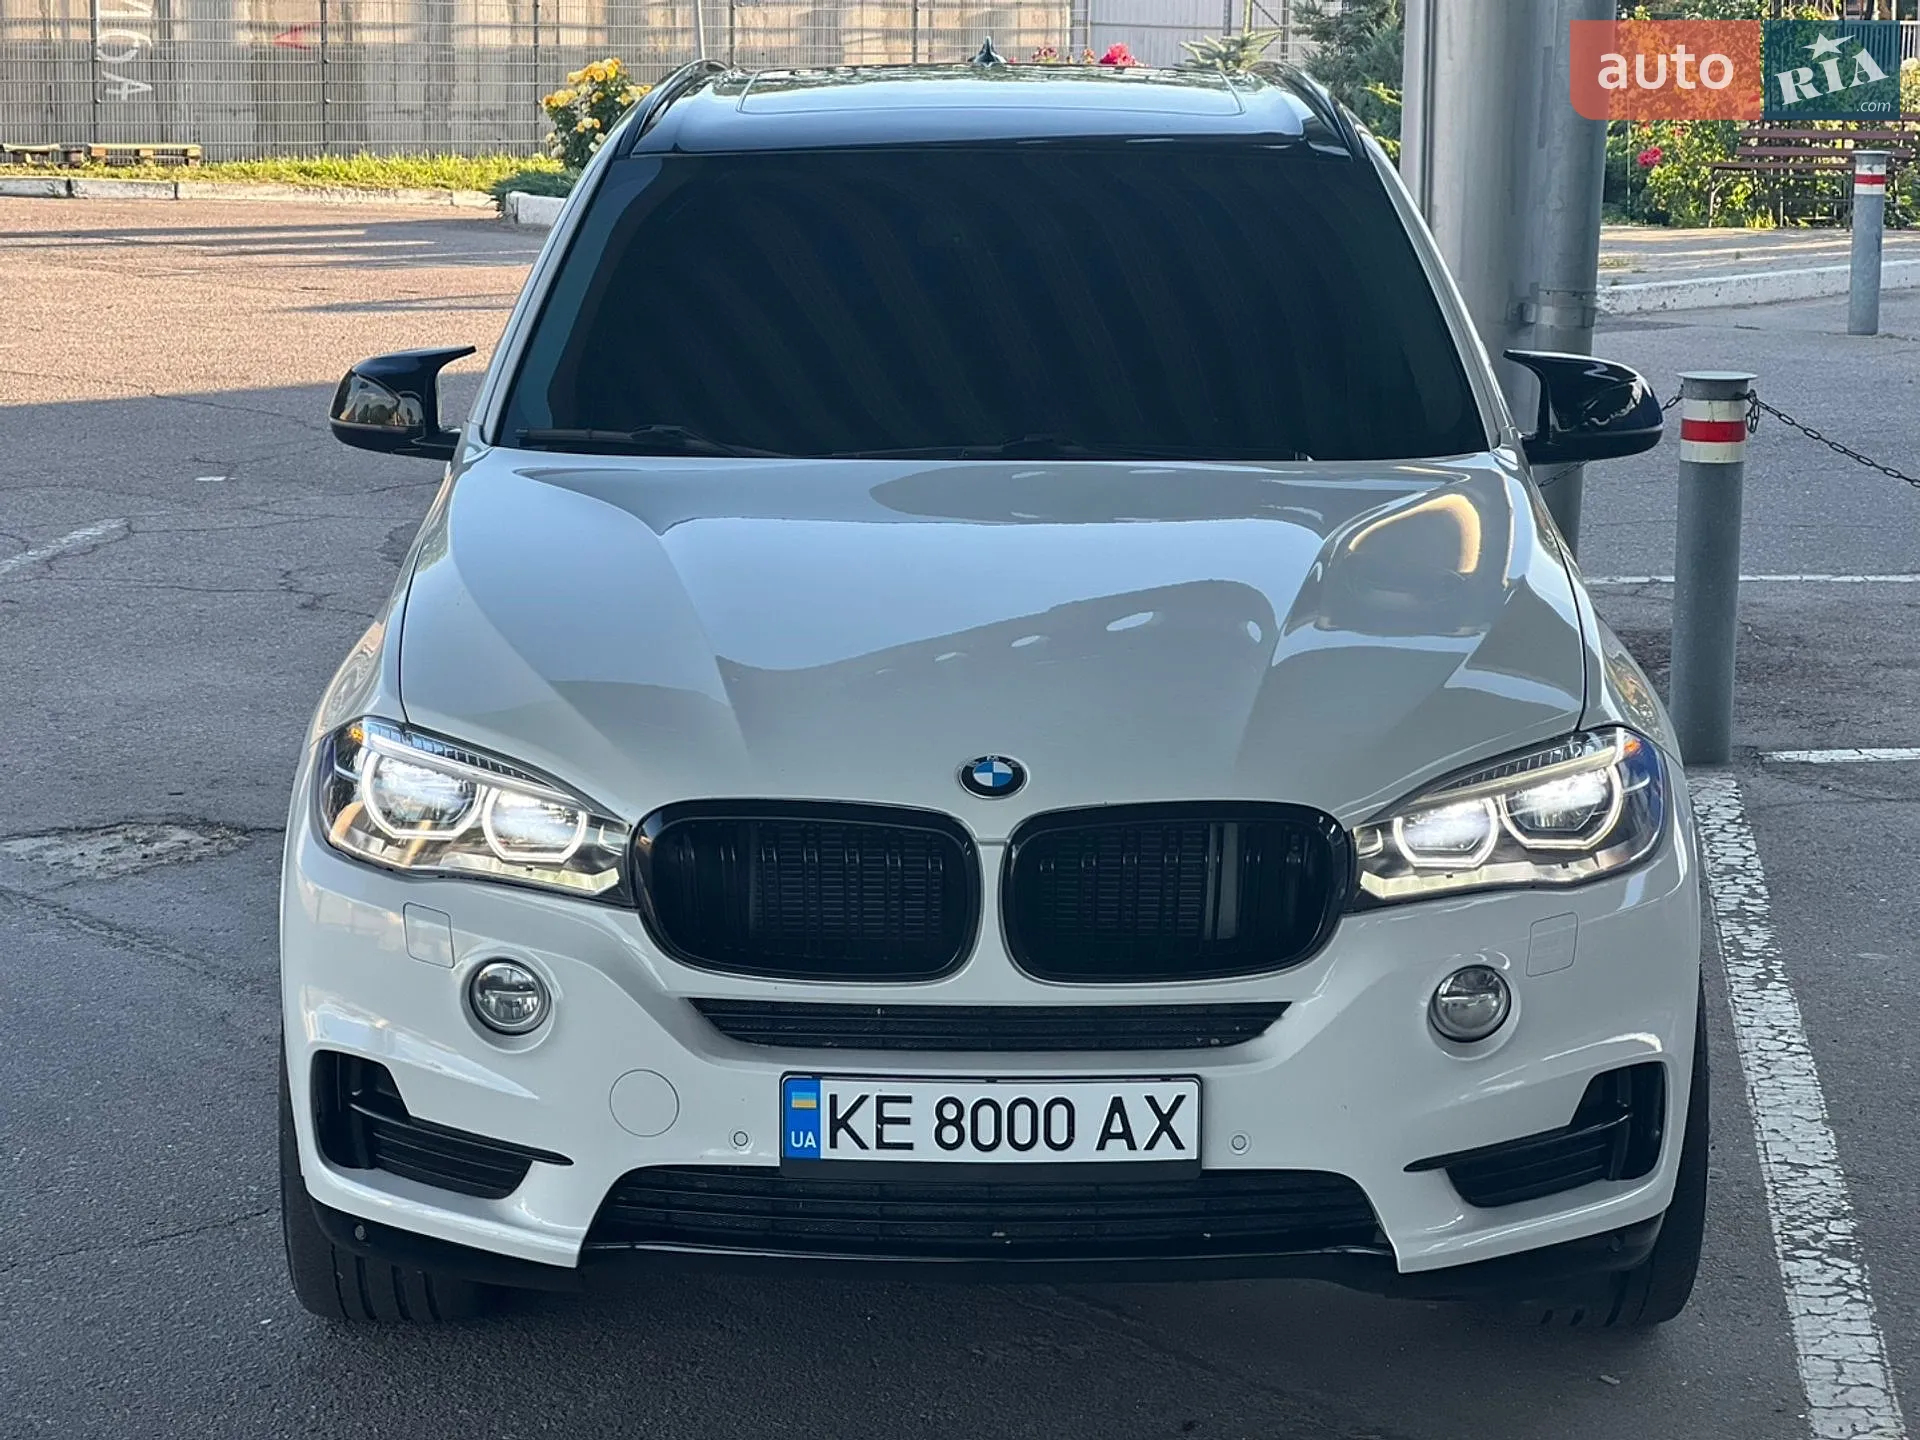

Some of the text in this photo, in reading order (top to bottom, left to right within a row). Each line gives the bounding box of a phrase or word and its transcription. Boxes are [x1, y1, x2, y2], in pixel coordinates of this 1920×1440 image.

[791, 1130, 817, 1149] UA
[828, 1094, 1187, 1152] KE 8000 AX
